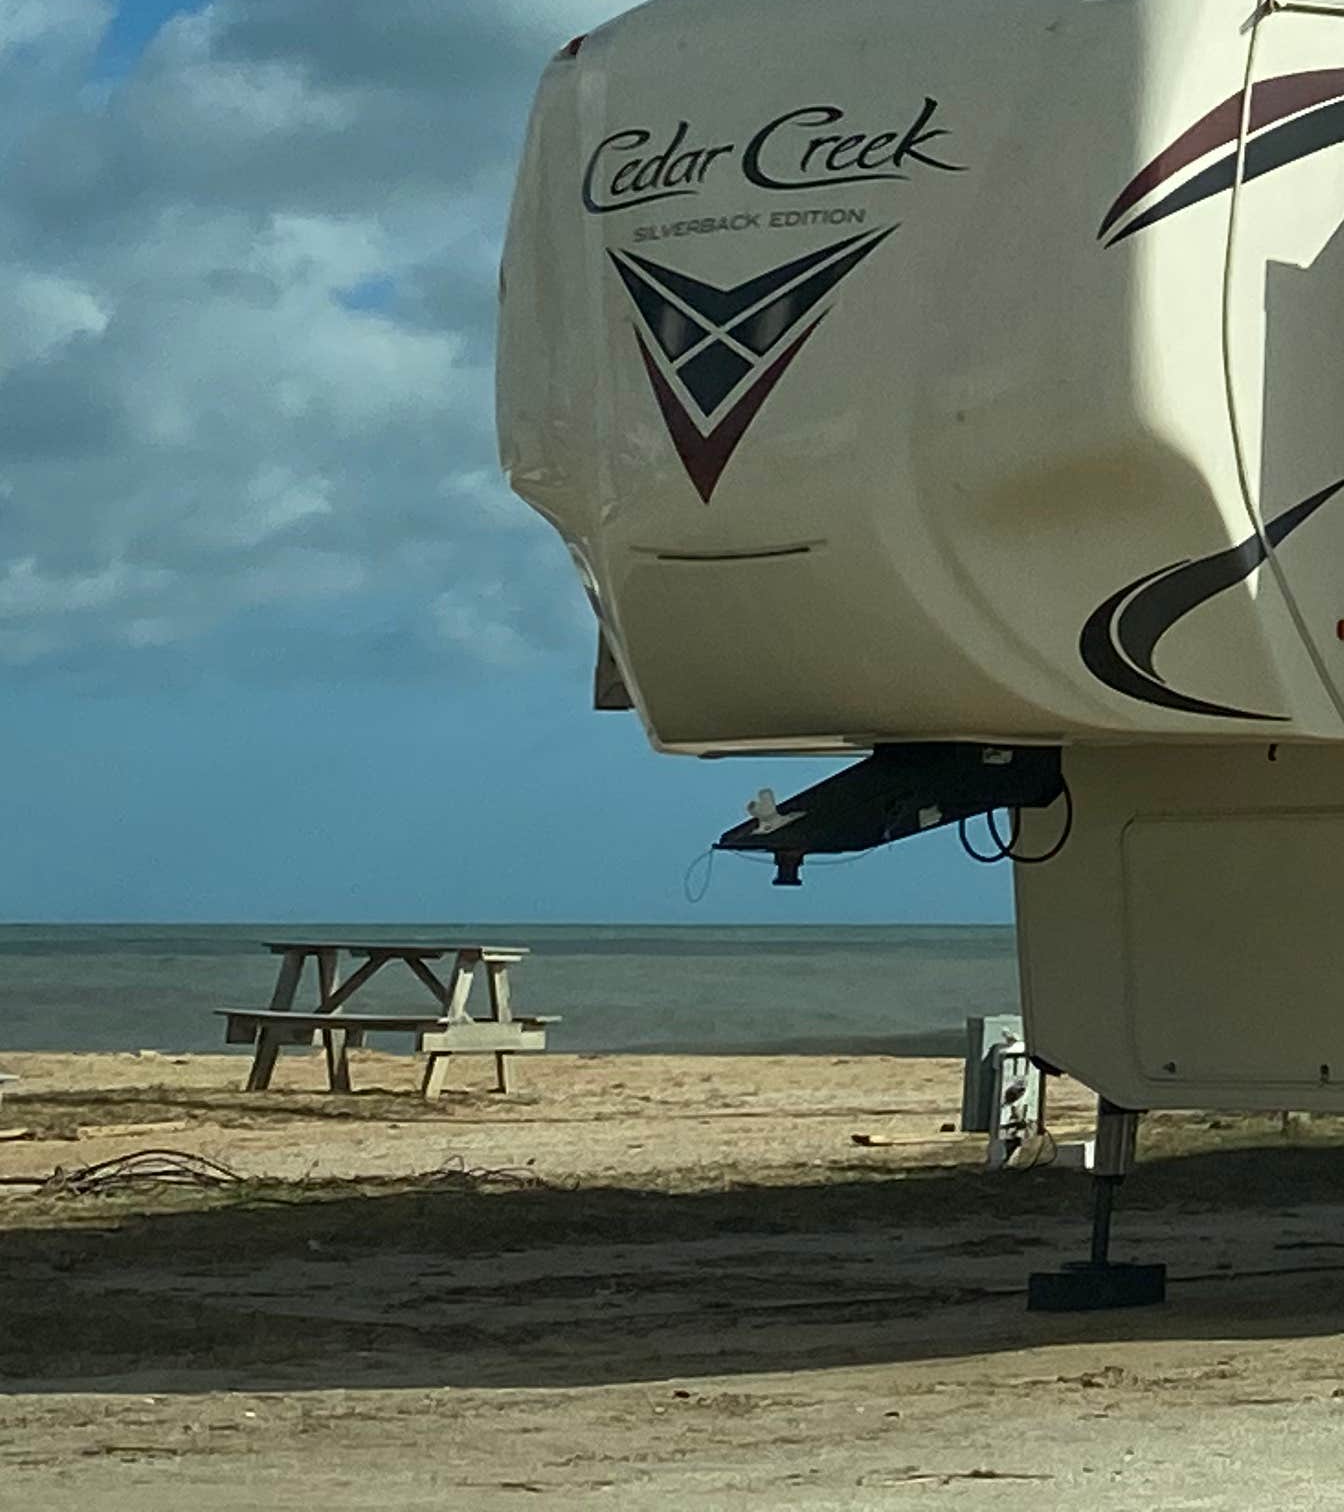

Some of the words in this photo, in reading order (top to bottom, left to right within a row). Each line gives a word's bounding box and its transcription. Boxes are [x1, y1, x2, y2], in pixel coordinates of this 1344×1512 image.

[582, 120, 734, 214] Cedar
[742, 97, 970, 190] Creek
[633, 213, 761, 243] SILVERBACK
[768, 209, 866, 230] EDITION
